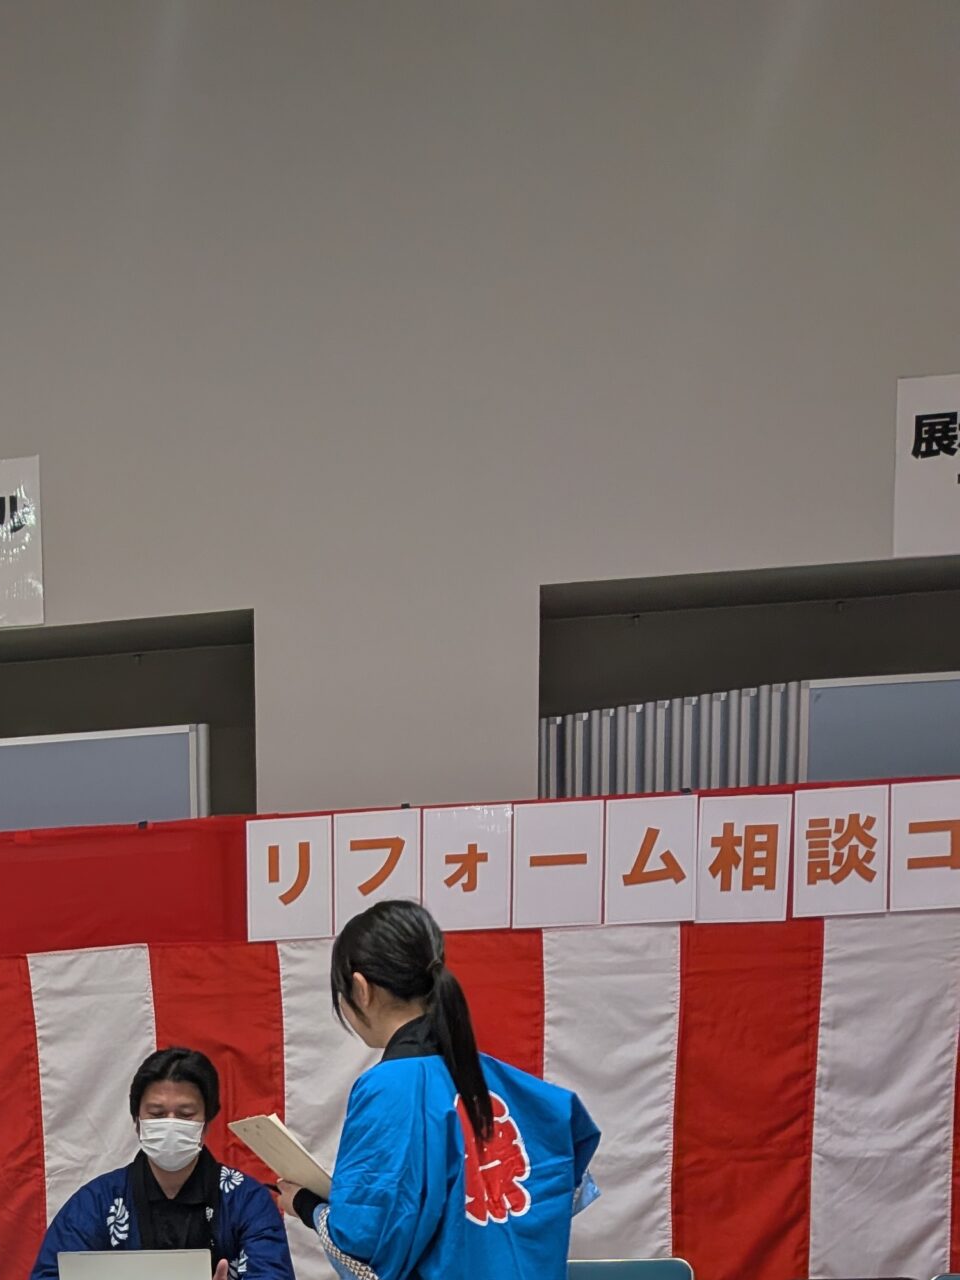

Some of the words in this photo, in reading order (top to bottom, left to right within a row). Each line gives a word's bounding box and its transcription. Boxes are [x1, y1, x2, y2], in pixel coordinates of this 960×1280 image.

[911, 411, 960, 460] 展
[267, 812, 960, 907] リフォーム相談コ
